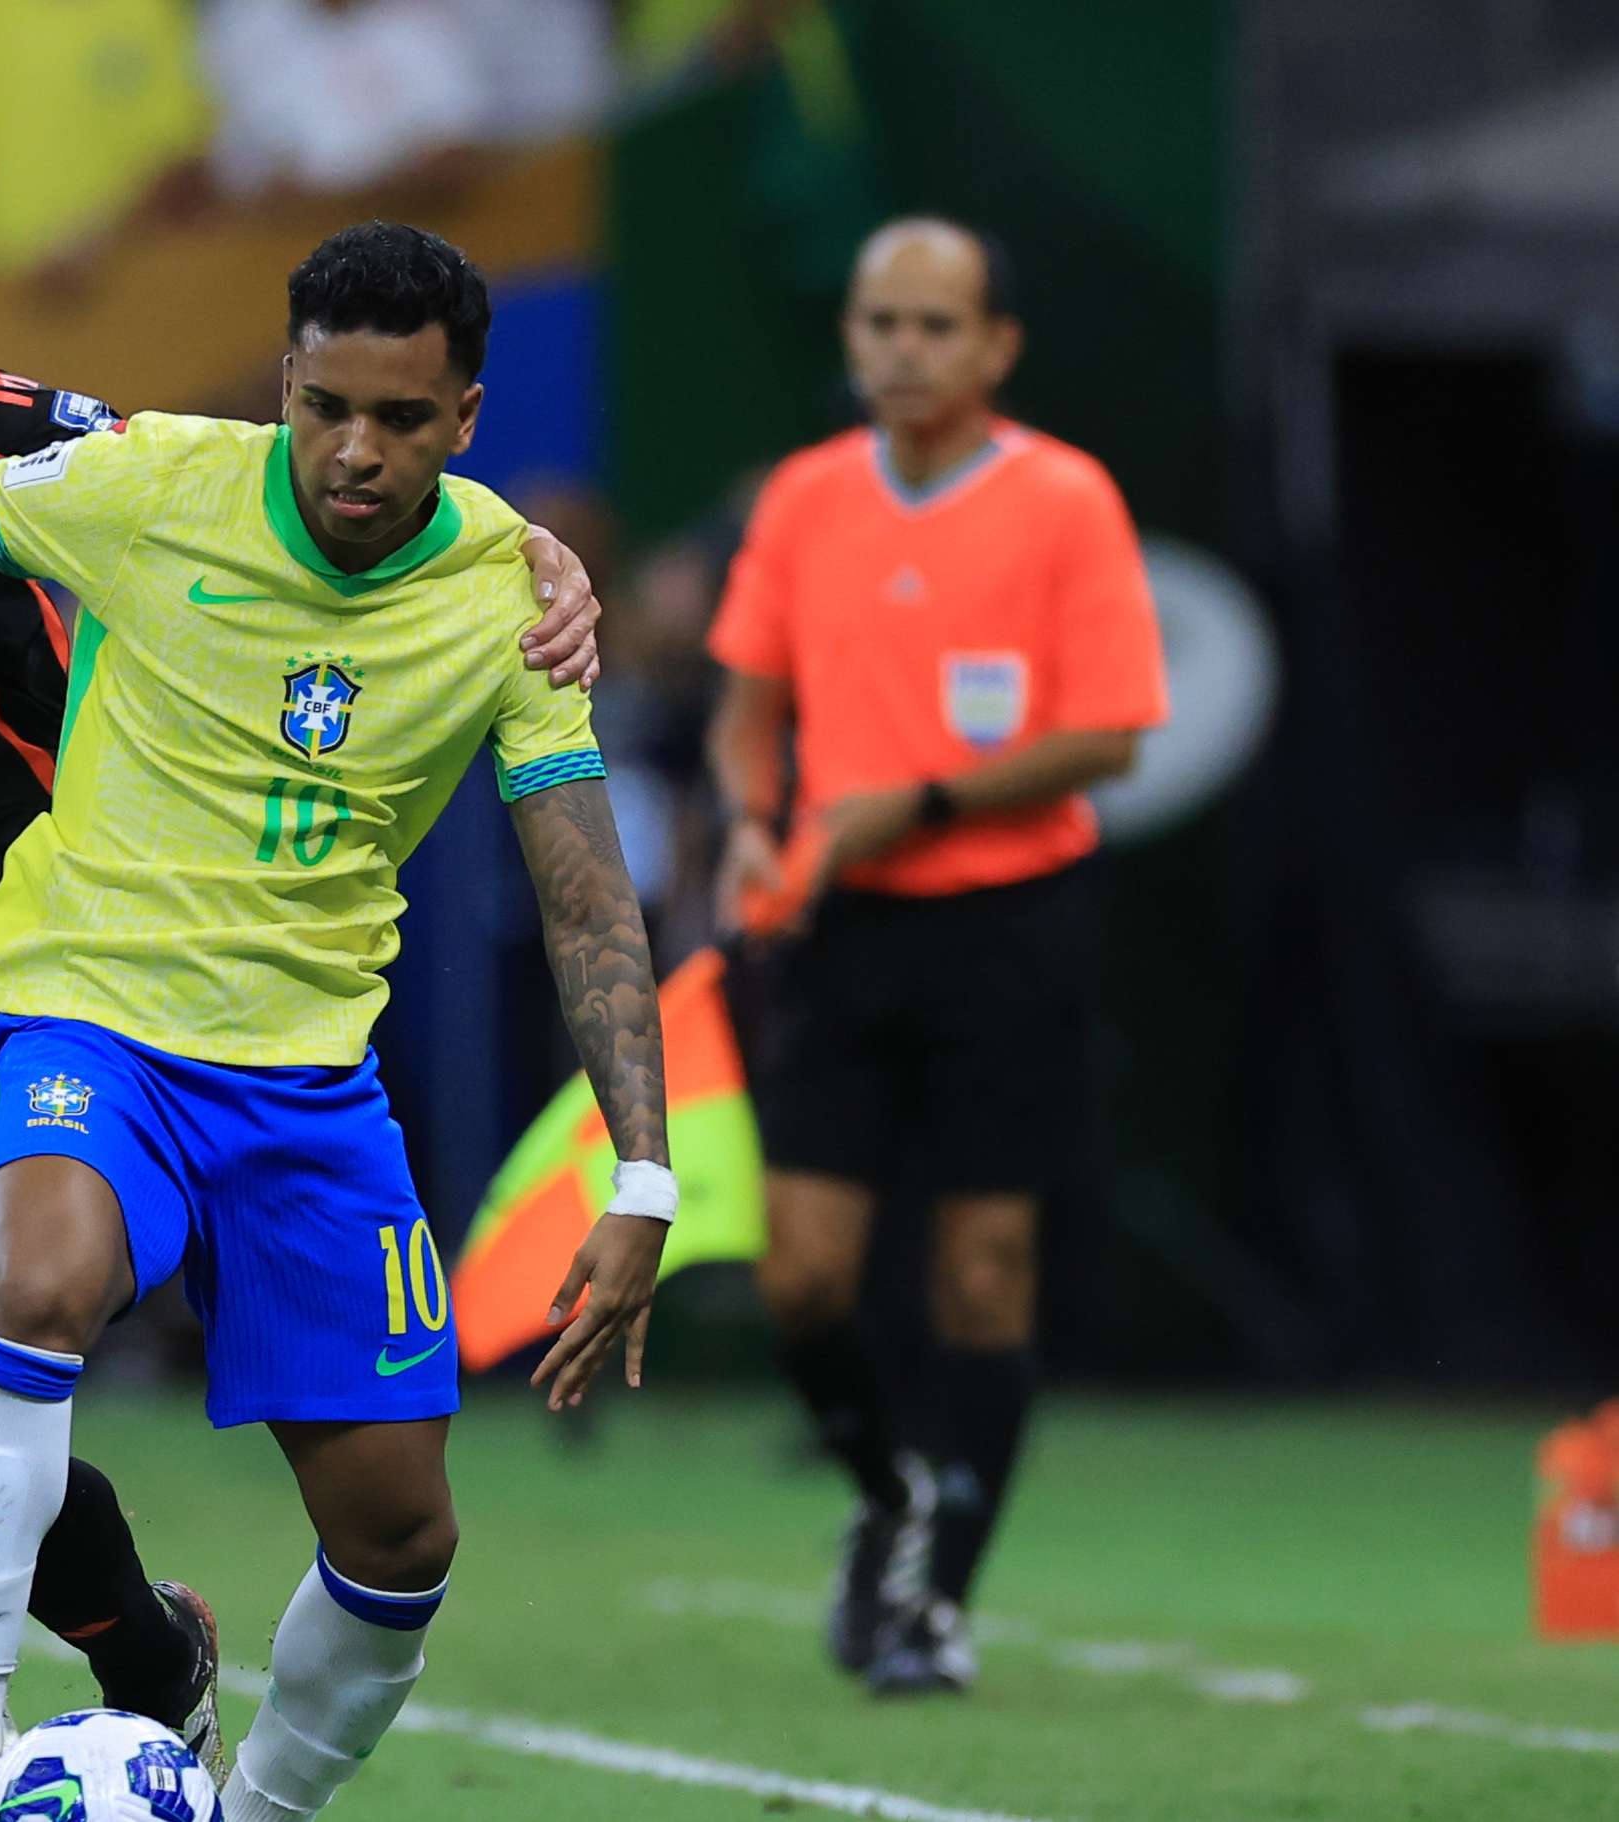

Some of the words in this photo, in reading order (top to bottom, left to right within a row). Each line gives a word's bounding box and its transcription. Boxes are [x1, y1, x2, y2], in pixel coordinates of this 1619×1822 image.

[303, 701, 332, 714] CBF
[255, 776, 352, 868] 10
[26, 1117, 89, 1134] BRASIL
[378, 1217, 447, 1335] 10
